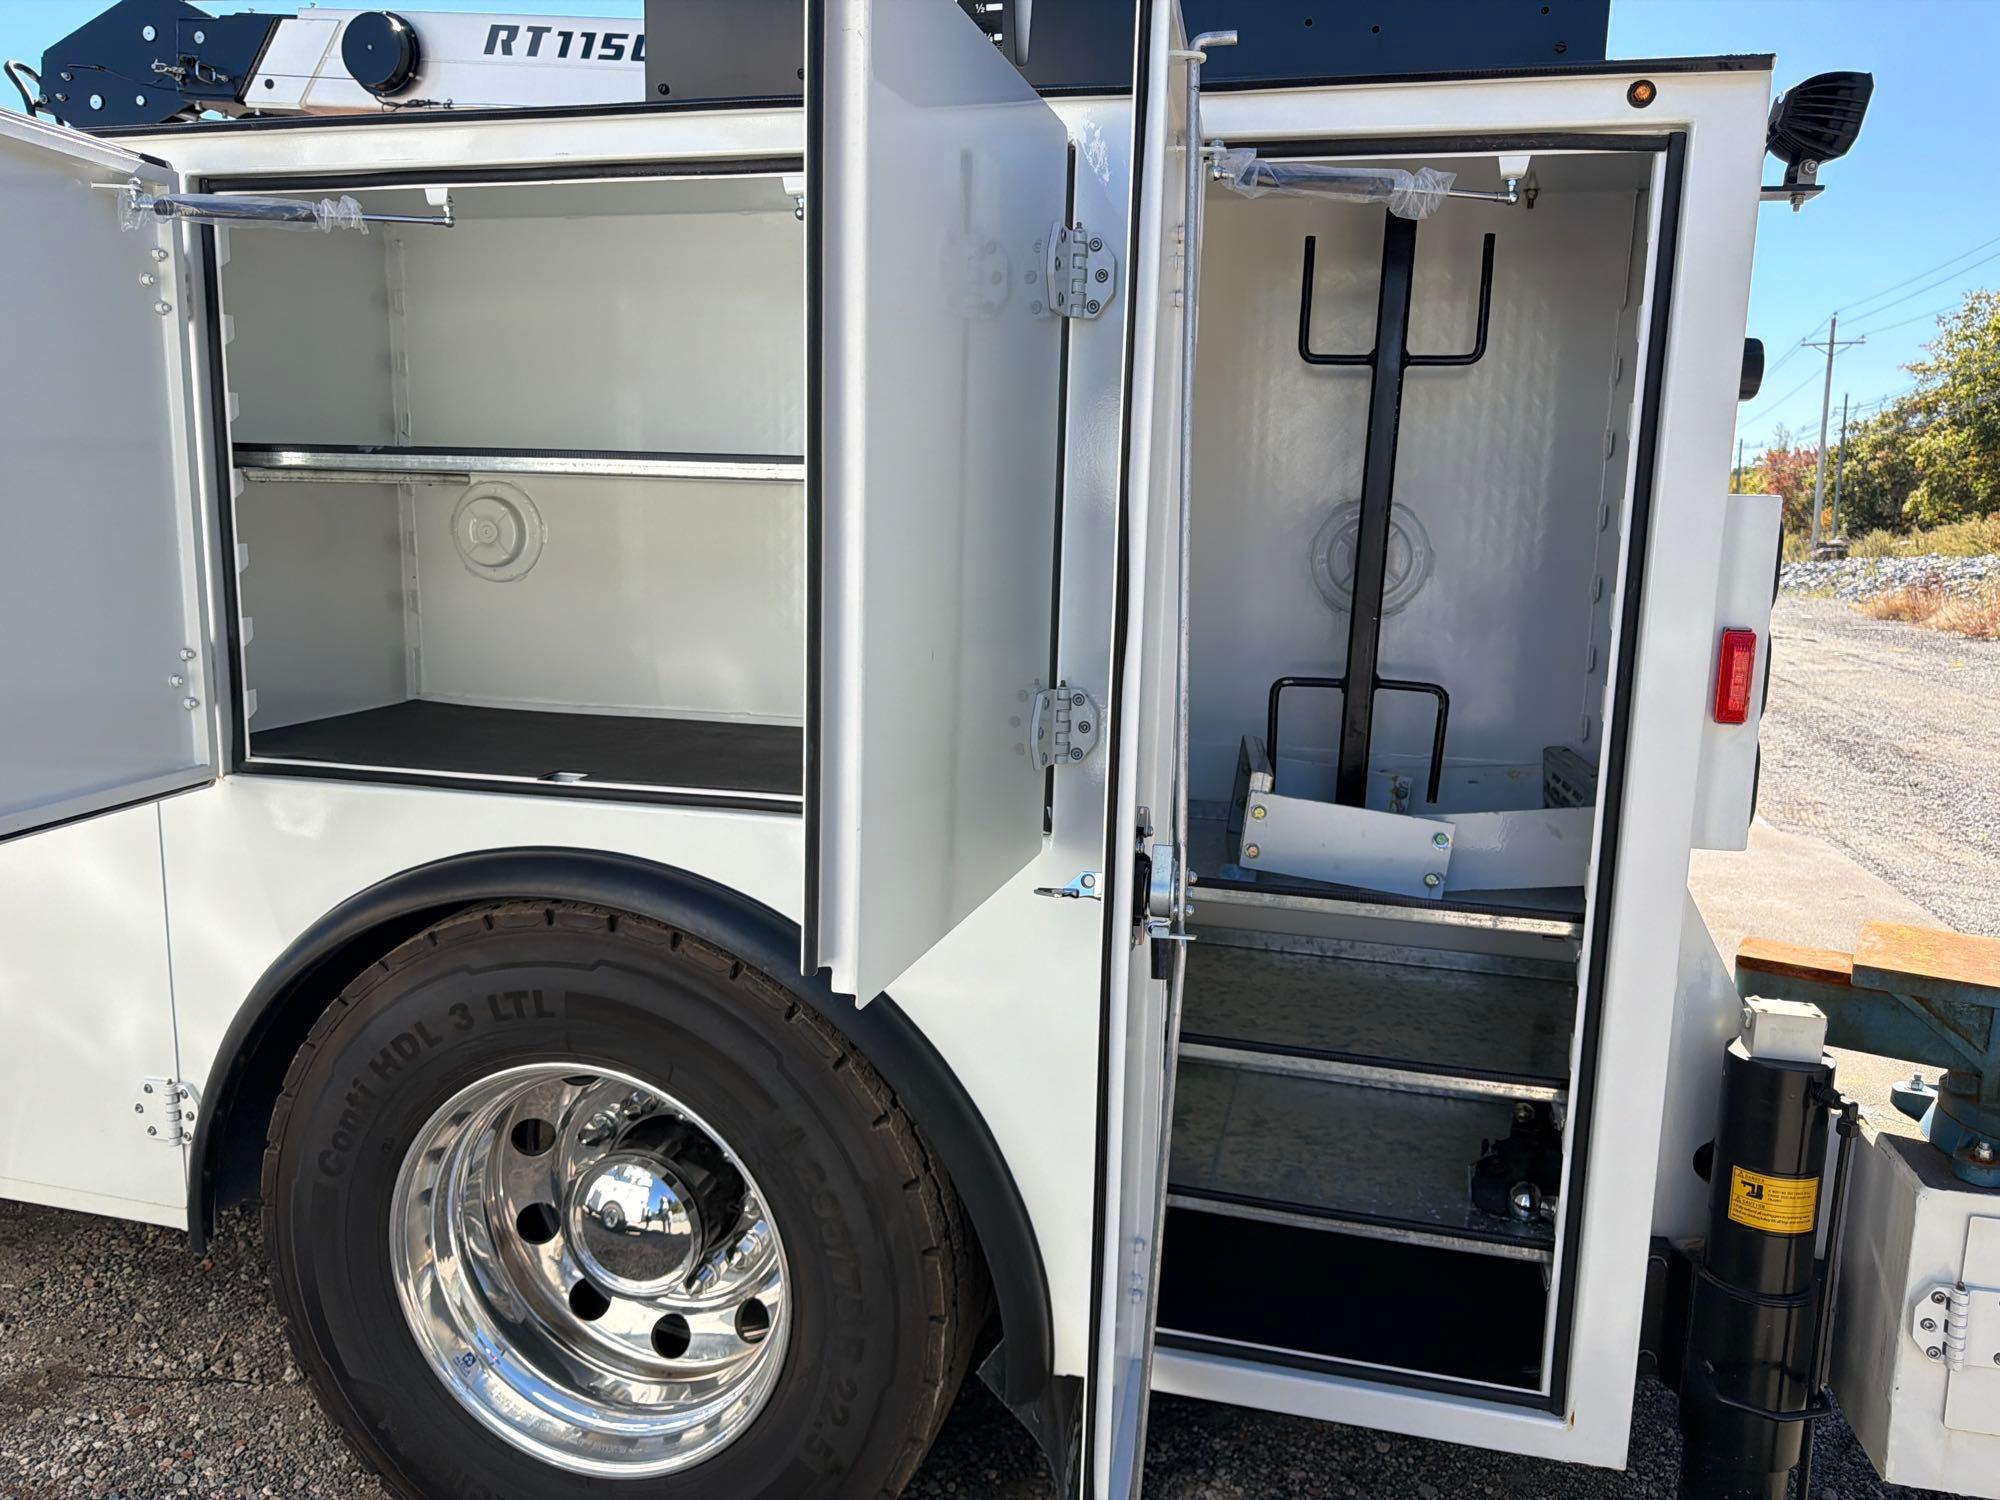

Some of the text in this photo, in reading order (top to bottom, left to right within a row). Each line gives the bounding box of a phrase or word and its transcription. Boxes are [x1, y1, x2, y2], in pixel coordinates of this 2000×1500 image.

[318, 989, 556, 1177] Conti HDL 3 LTL
